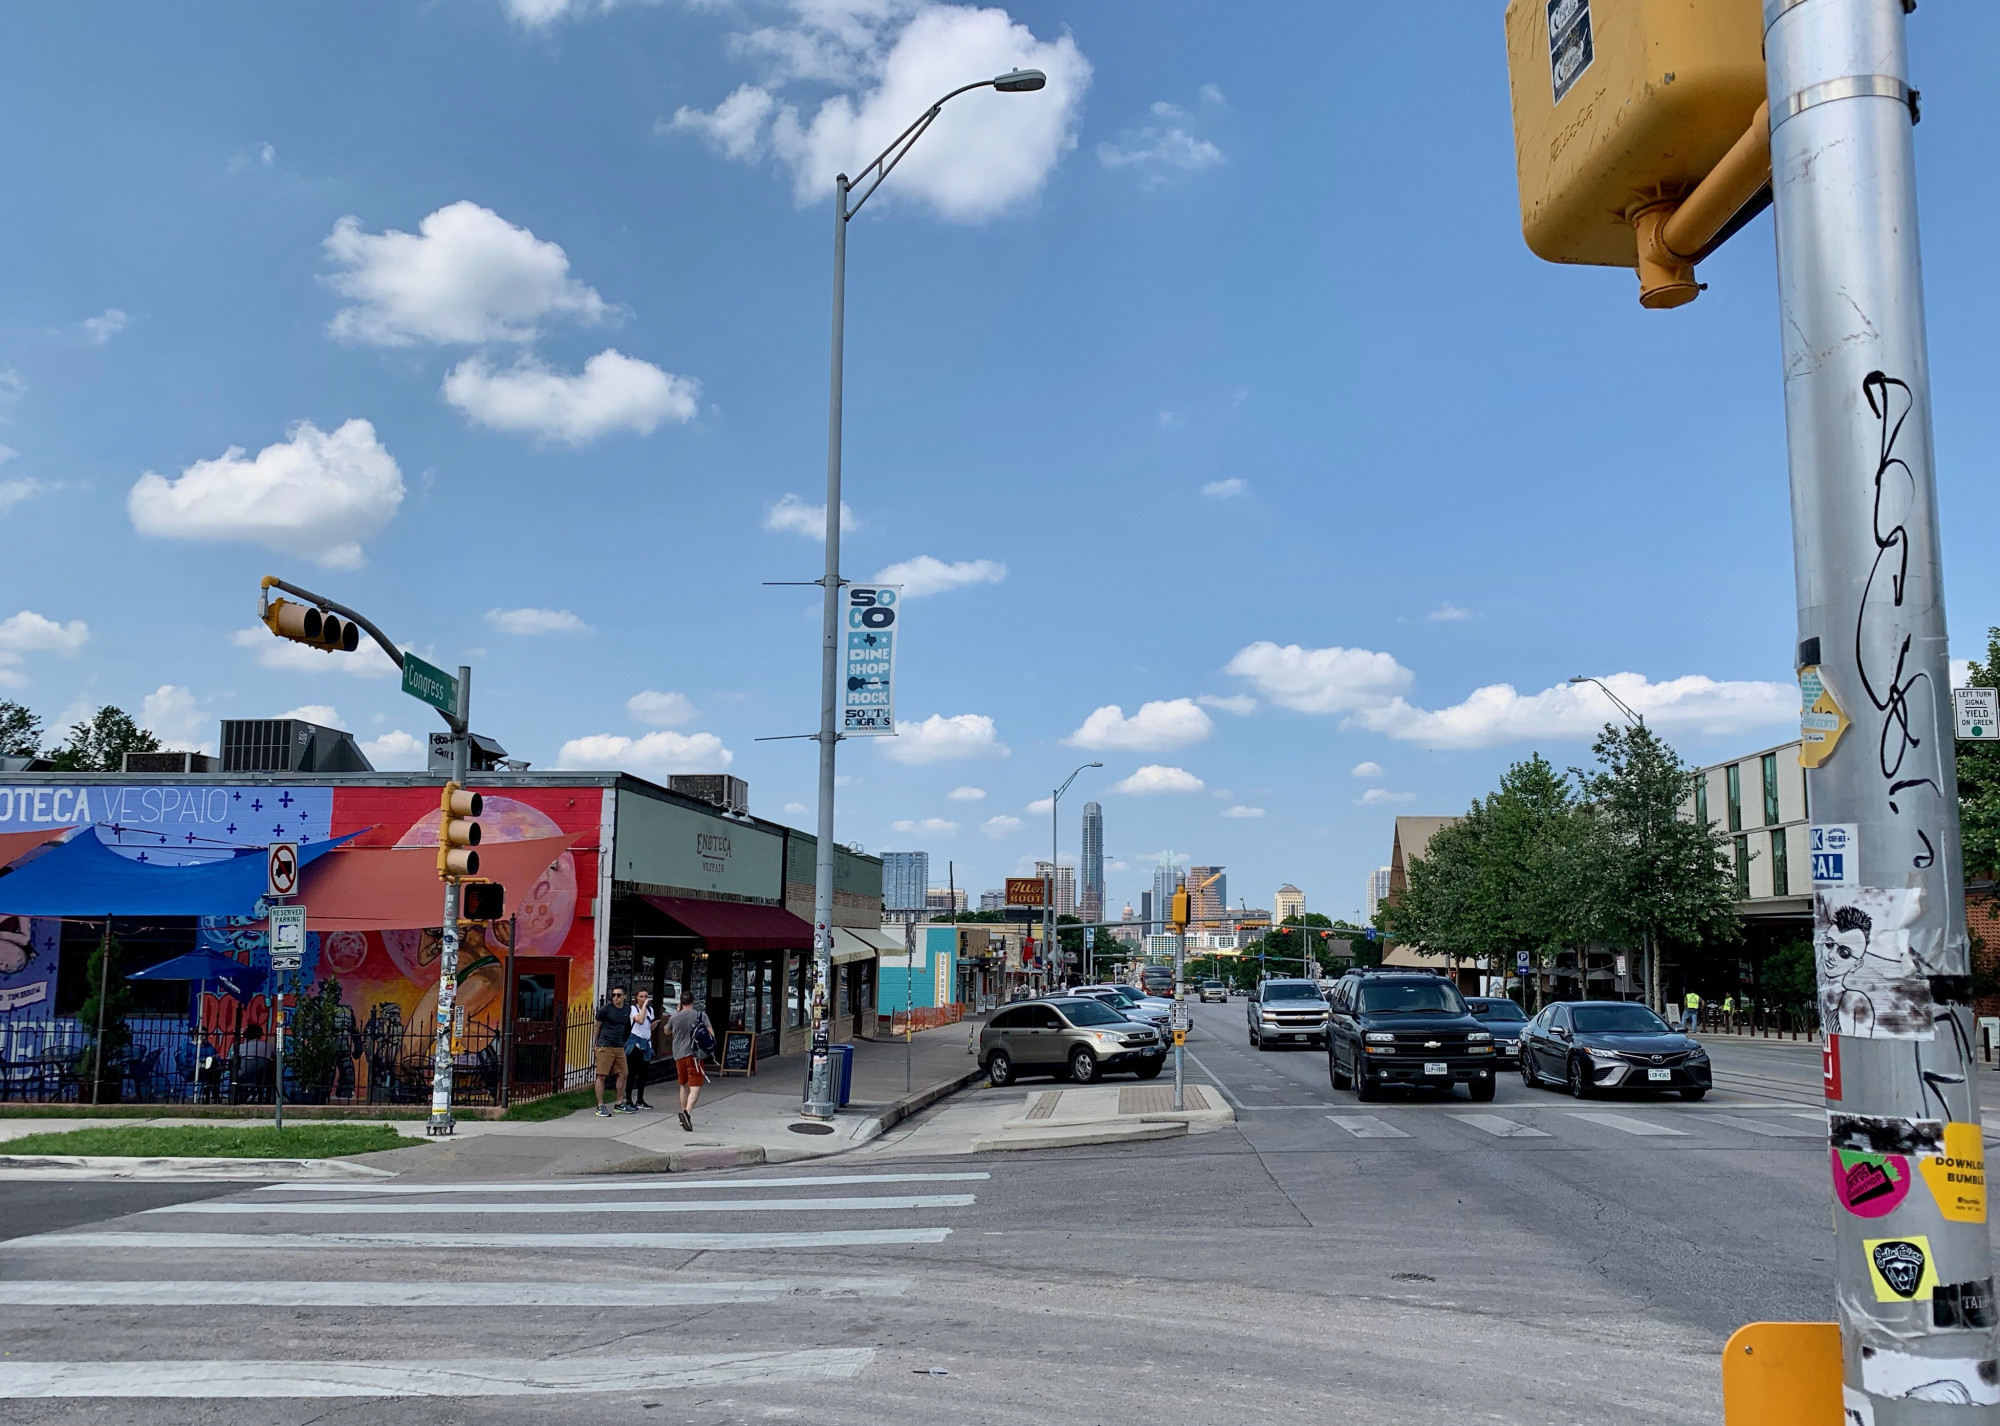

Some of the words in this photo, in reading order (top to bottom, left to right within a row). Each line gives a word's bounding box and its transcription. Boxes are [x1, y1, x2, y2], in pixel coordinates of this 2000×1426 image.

[850, 589, 896, 607] SO
[849, 607, 895, 628] CO
[850, 648, 889, 660] DINE
[850, 662, 889, 675] SHOP
[409, 664, 444, 701] Congress
[848, 692, 888, 704] ROCK
[845, 708, 890, 718] SOUTH
[1965, 709, 1988, 717] YIELD
[845, 717, 890, 726] CONGRESS
[103, 788, 228, 823] VESPAIO
[697, 833, 732, 858] ENOTECA
[703, 861, 725, 873] VESPAIO
[1011, 895, 1045, 903] BOOT
[273, 908, 303, 916] RESERVED
